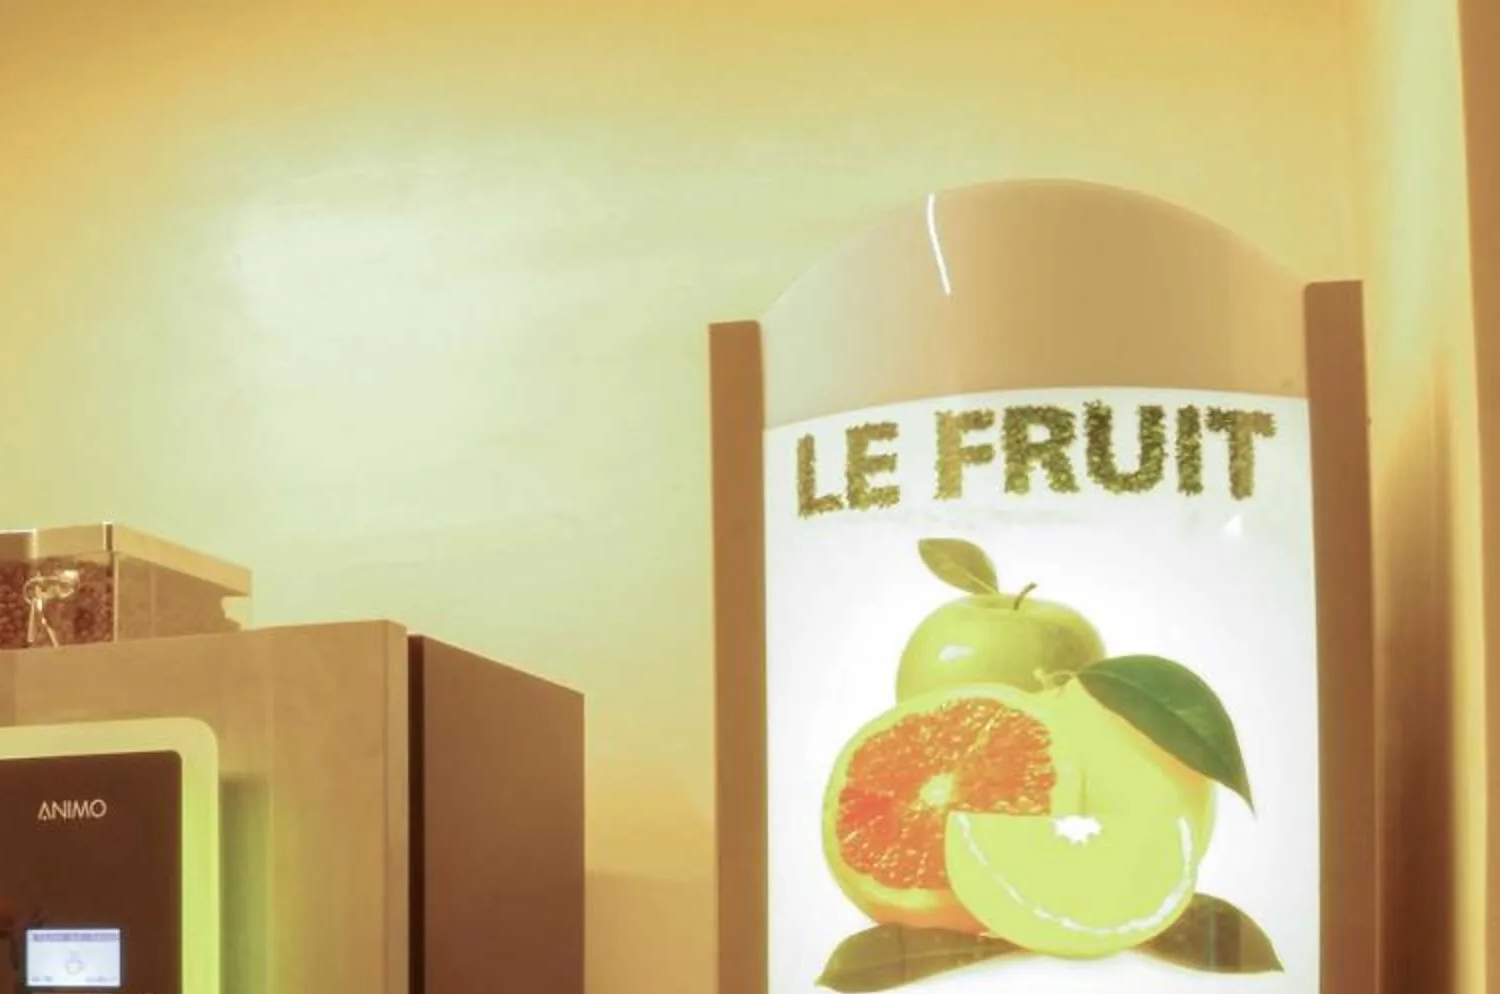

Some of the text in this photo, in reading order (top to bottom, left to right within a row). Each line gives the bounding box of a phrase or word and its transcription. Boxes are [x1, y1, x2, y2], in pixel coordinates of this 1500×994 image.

[796, 399, 1278, 519] LE FRUIT
[37, 798, 107, 821] ANIMO
